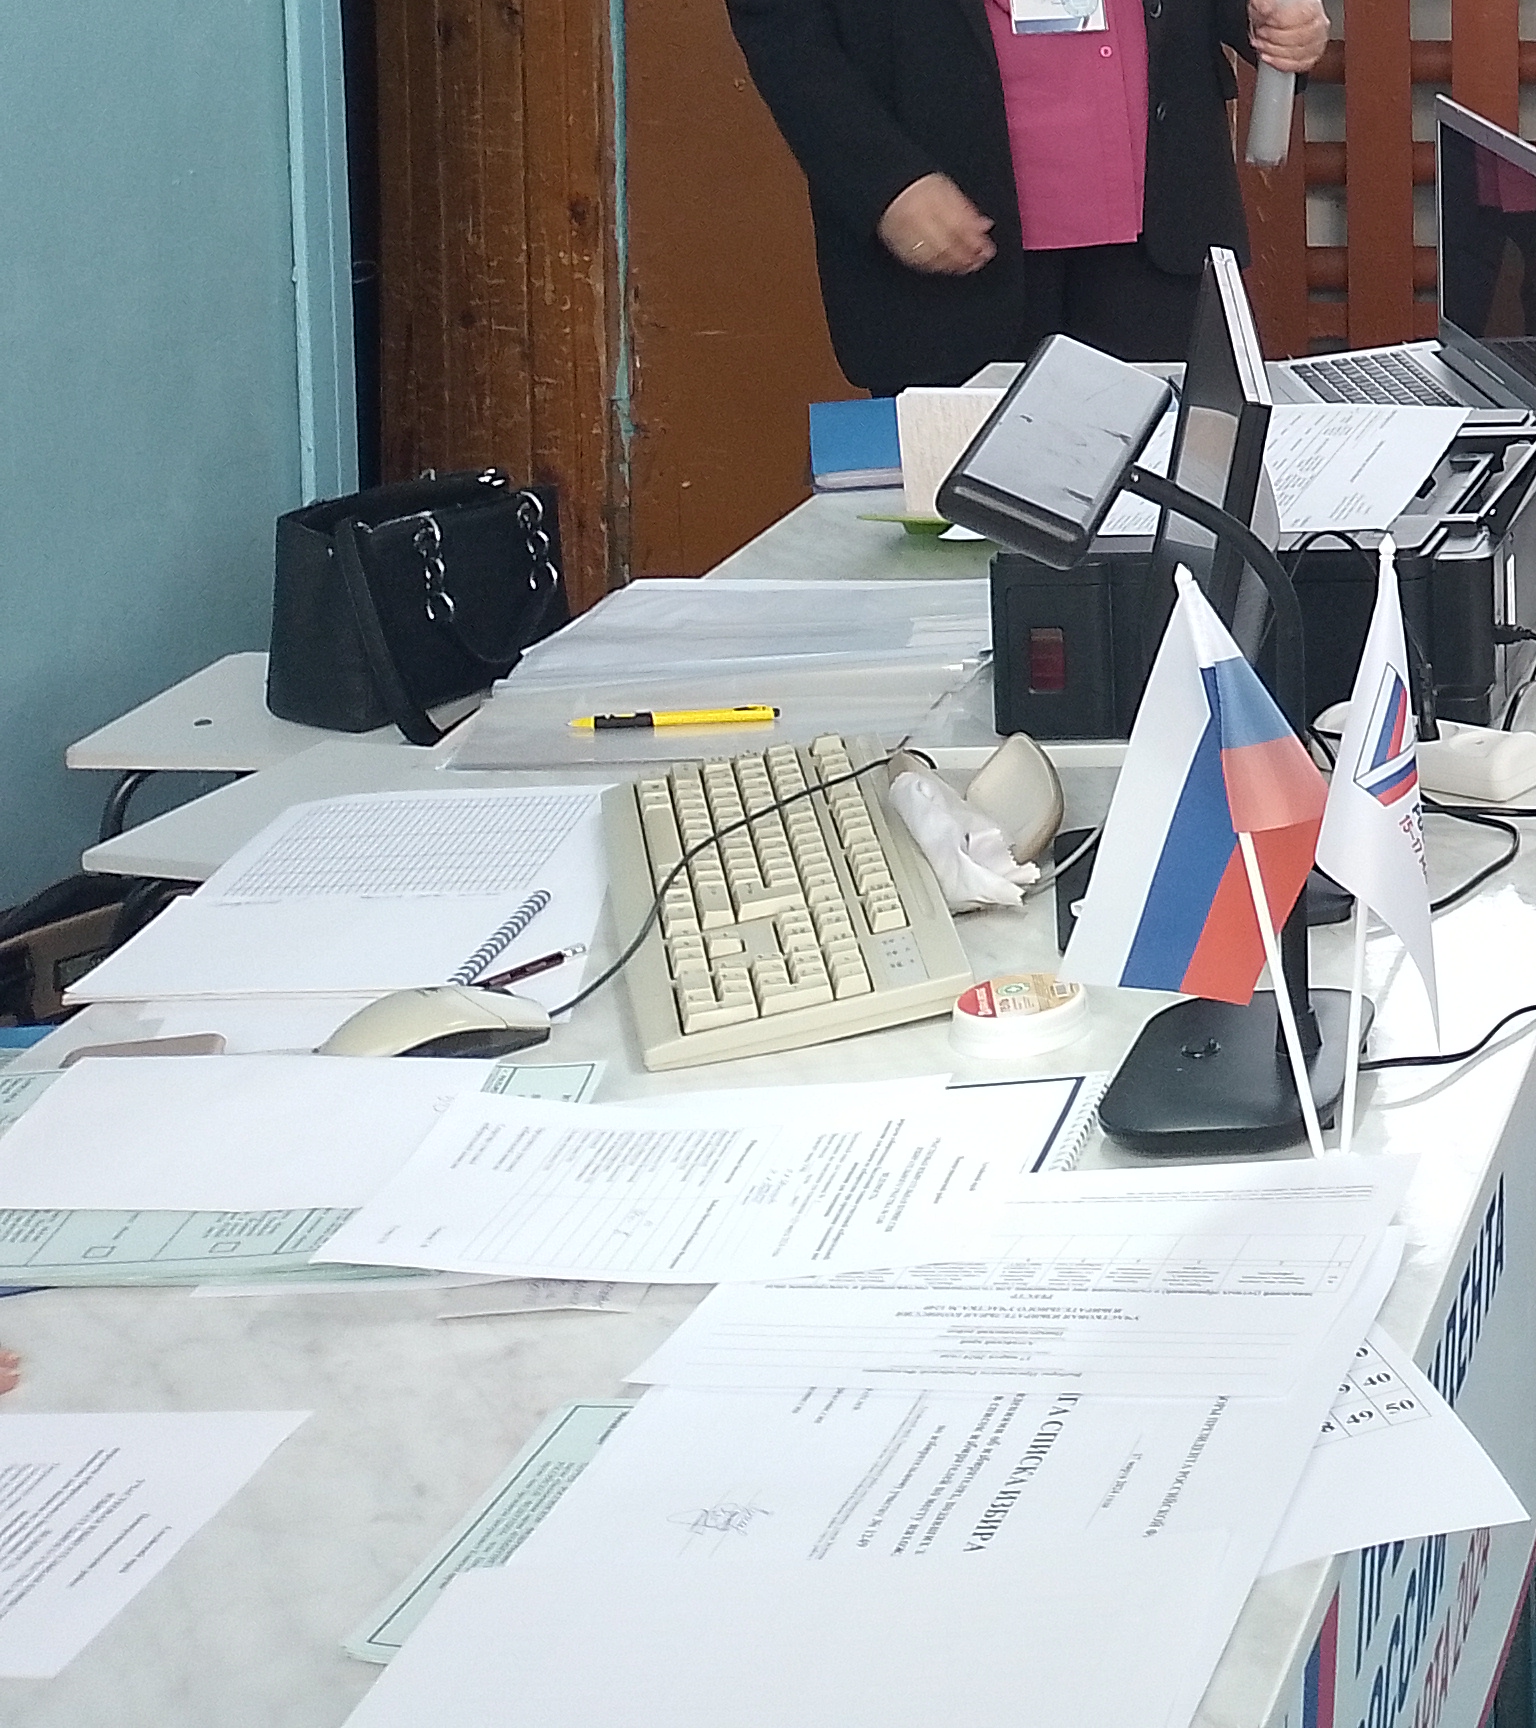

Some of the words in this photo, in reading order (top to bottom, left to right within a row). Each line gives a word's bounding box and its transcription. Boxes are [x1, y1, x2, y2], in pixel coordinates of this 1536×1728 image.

[1363, 1372, 1391, 1386] 40
[1346, 1410, 1374, 1423] 49
[1385, 1399, 1415, 1414] 50
[1002, 1420, 1068, 1485] СПИСКА
[958, 1490, 1023, 1552] ИЗБИРА
